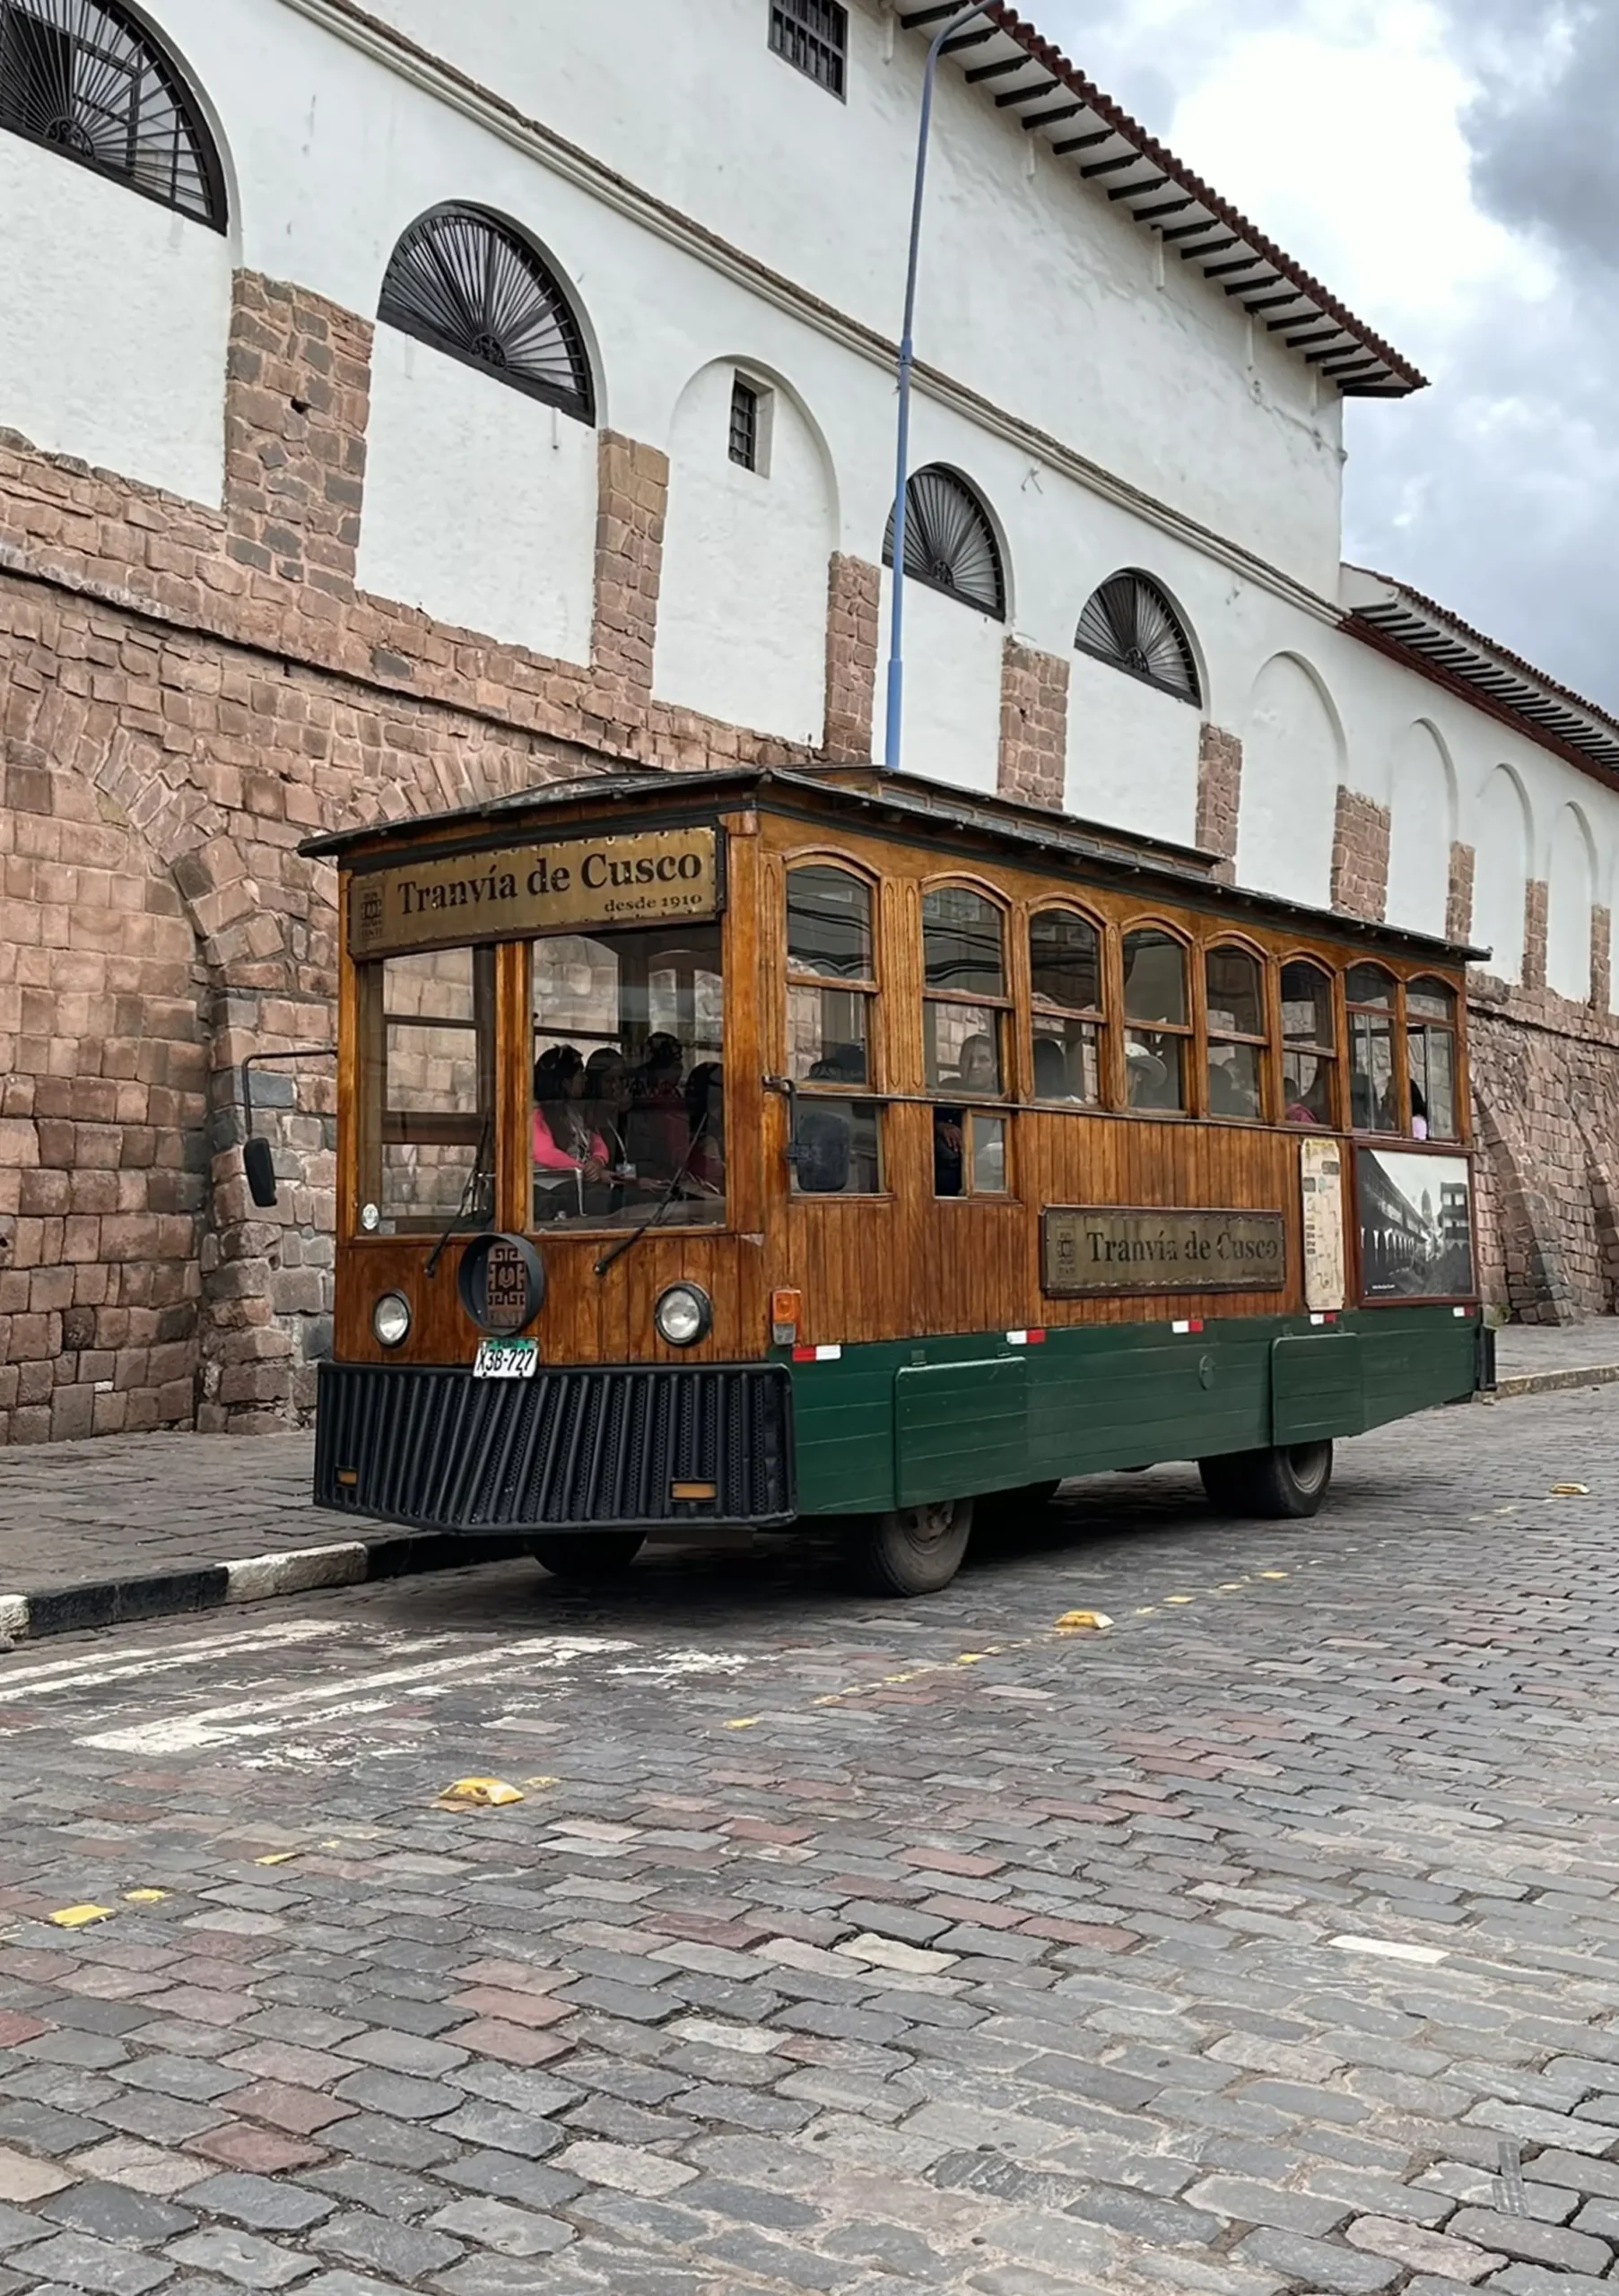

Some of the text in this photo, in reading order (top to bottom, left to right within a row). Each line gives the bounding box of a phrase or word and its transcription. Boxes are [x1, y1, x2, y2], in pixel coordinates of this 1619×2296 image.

[397, 852, 702, 916] Tranvía de Cusco
[605, 894, 702, 913] desde 1910
[1086, 1230, 1178, 1263] Tranvía
[1185, 1231, 1212, 1260] de
[1216, 1231, 1278, 1261] Cusco
[476, 1349, 535, 1371] X3B-727
